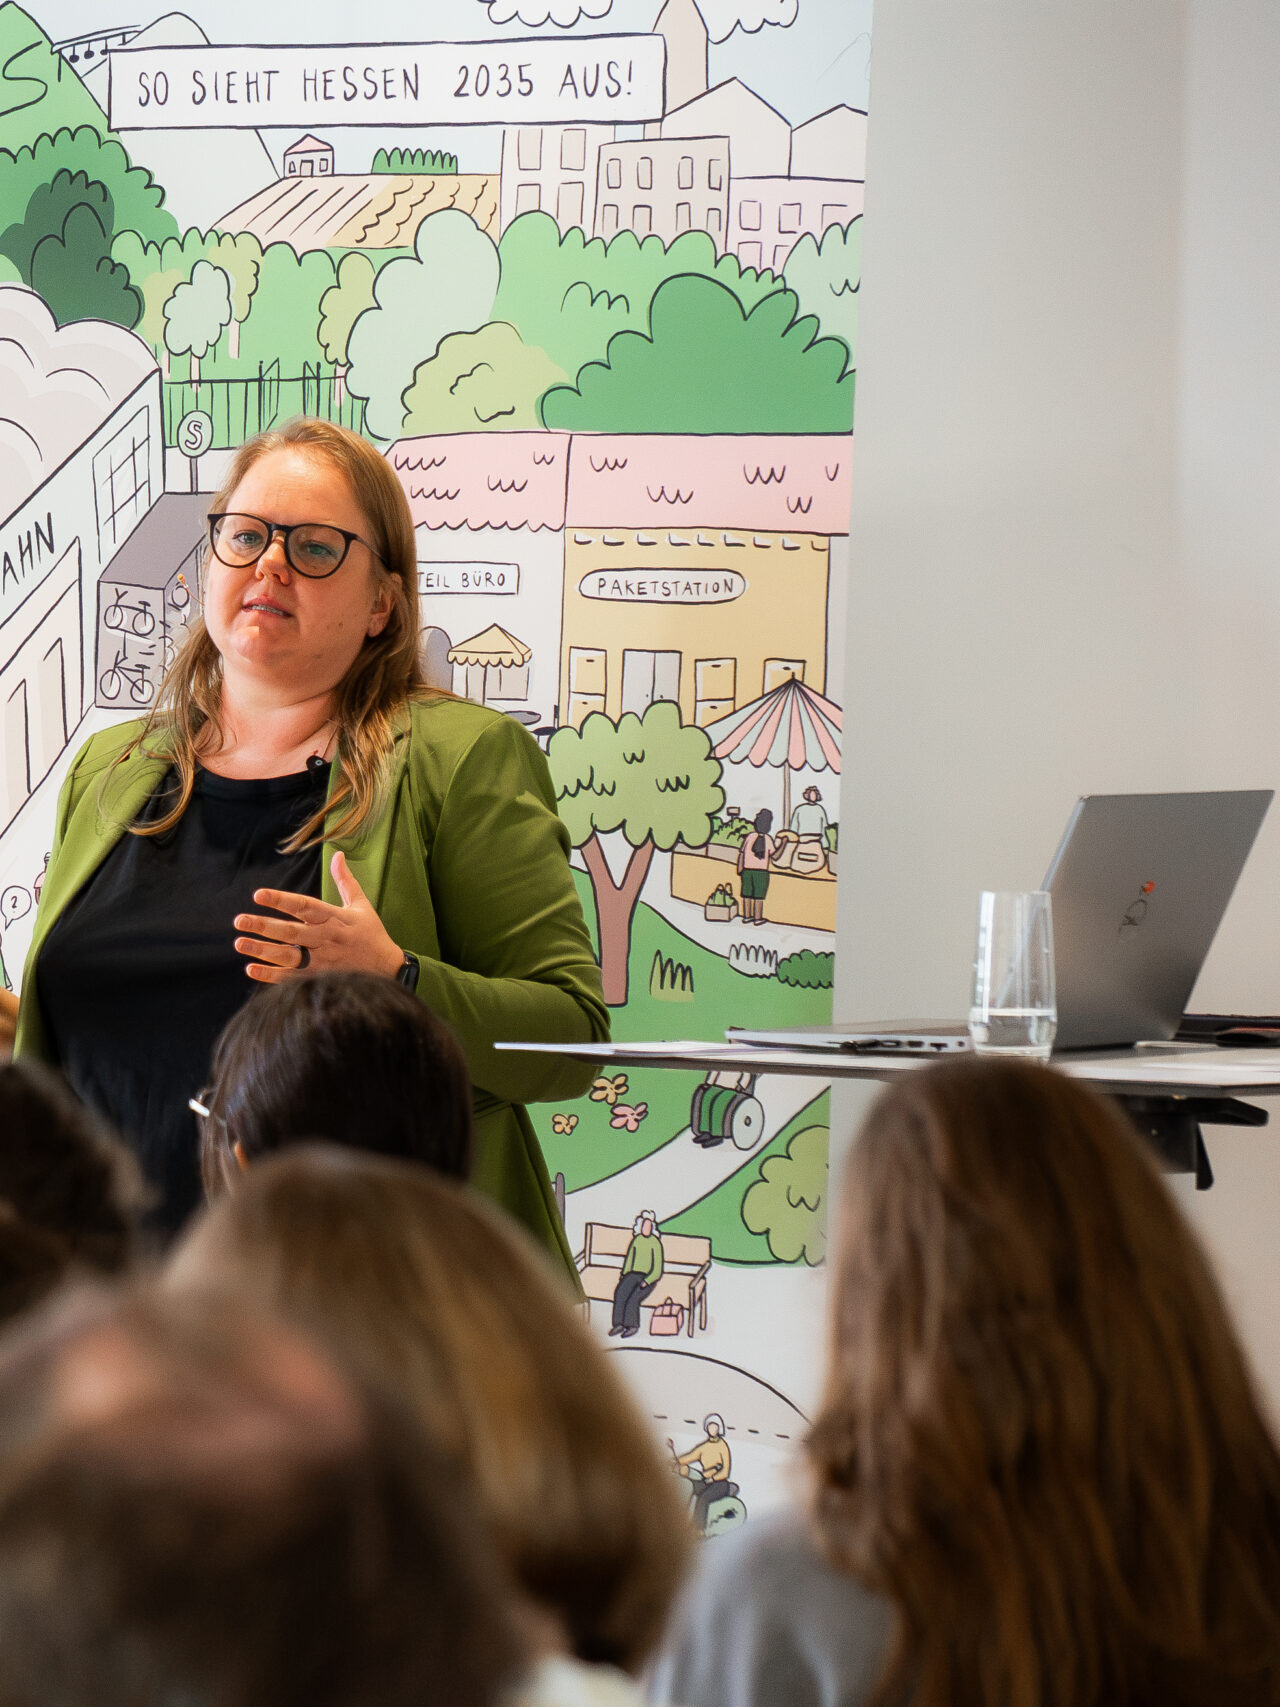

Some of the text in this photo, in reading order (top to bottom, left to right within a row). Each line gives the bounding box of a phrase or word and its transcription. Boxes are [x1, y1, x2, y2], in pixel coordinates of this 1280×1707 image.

[138, 60, 633, 107] SO SIEHT HESSEN 2035 AUS!
[184, 419, 203, 450] S
[461, 570, 506, 588] BÜRO
[597, 577, 734, 597] PAKETSTATION
